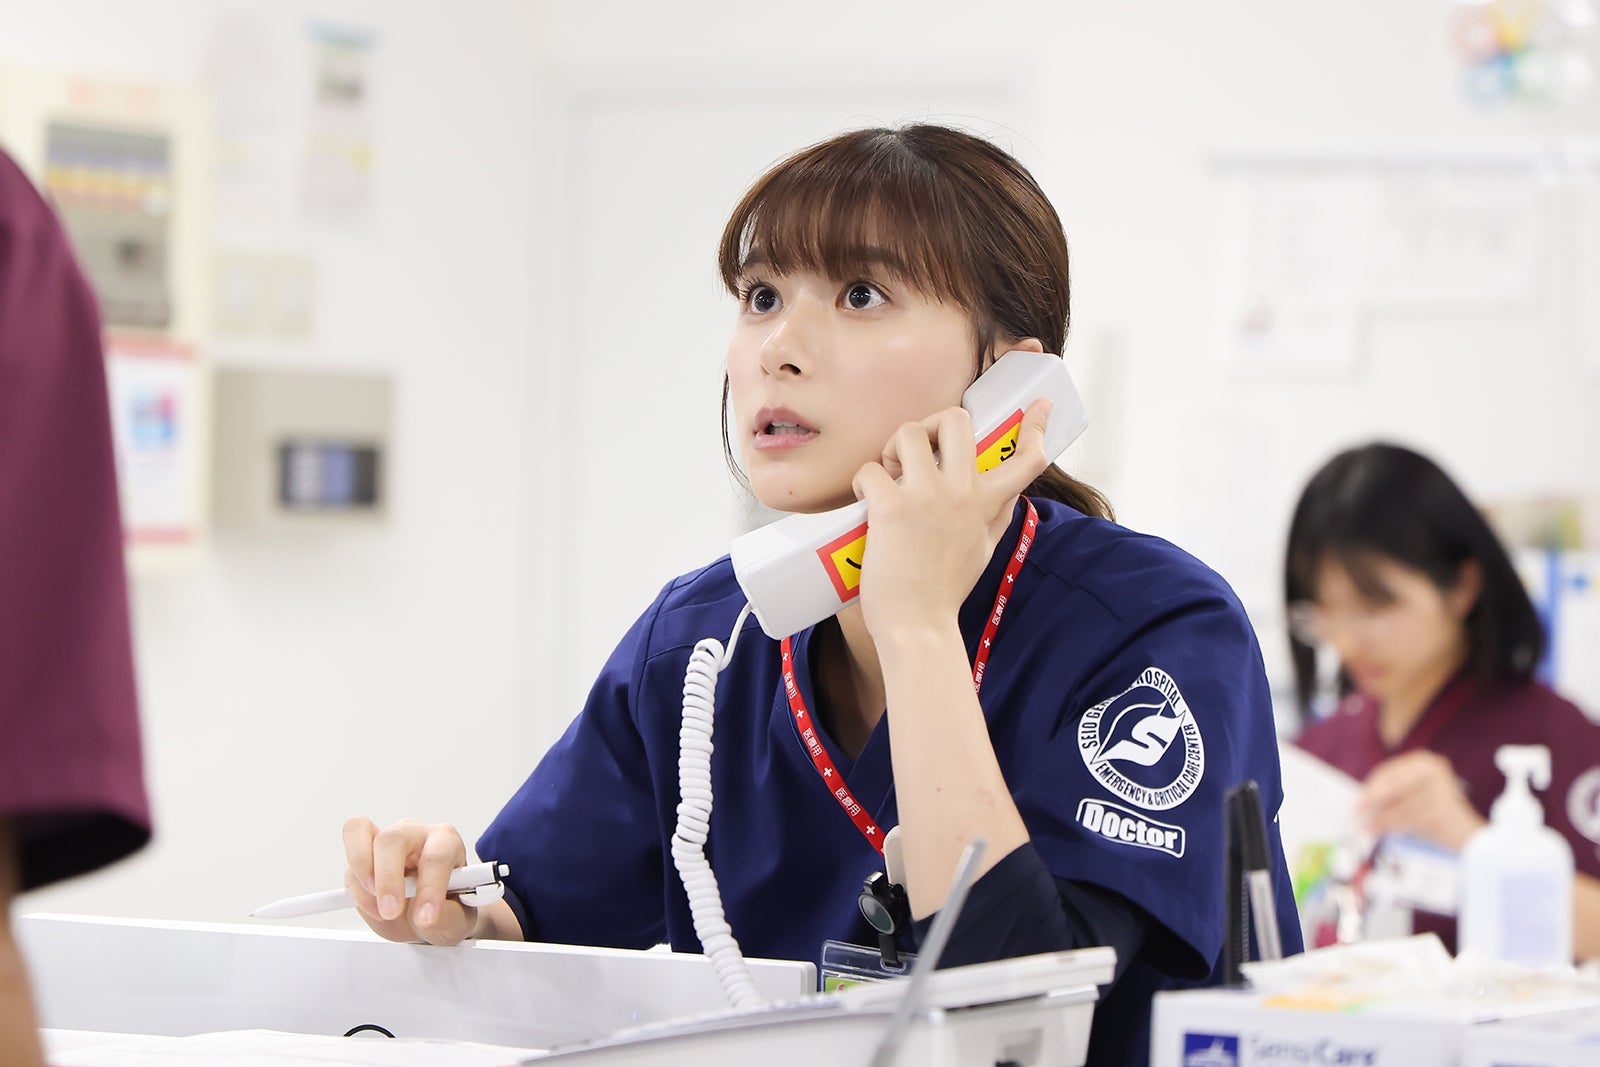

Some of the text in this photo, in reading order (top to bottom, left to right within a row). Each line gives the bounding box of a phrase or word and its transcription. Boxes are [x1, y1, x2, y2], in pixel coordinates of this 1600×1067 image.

[1081, 722, 1098, 749] SEIO
[1095, 723, 1201, 806] EMERGENCY & CRITICAL CARE CENTER
[1082, 803, 1178, 849] Doctor
